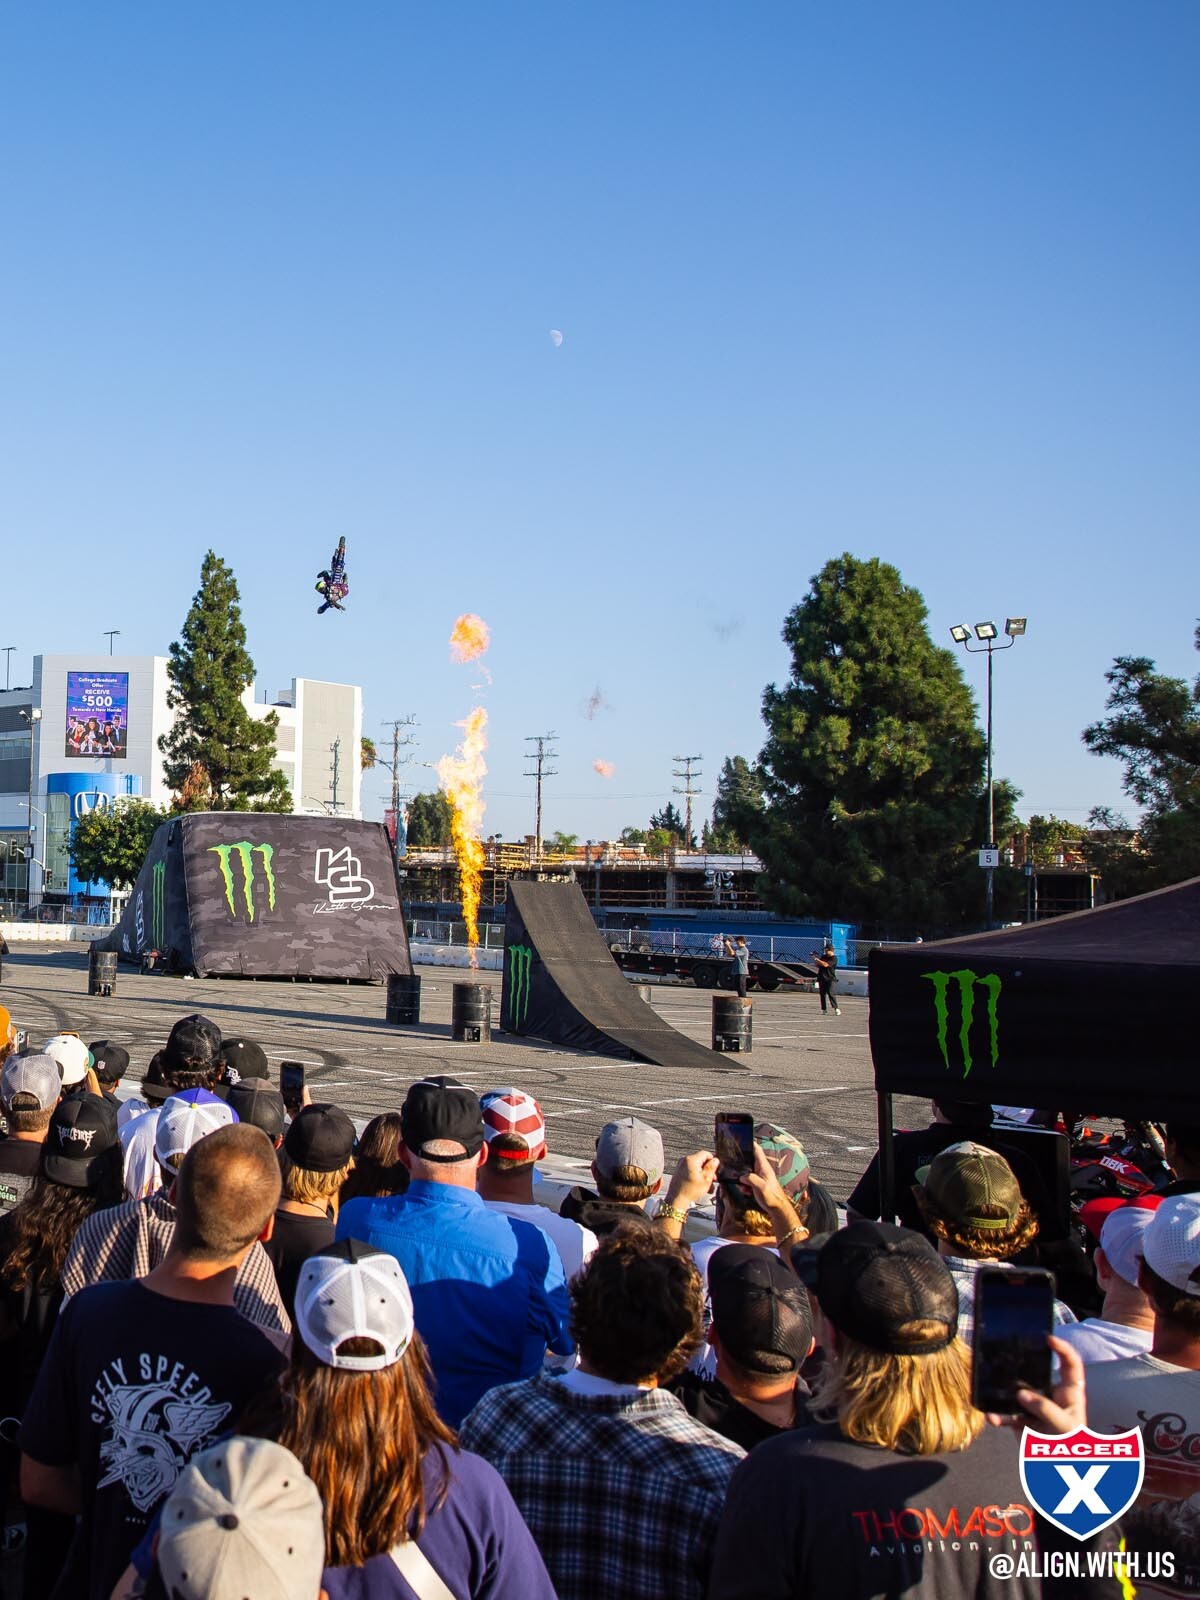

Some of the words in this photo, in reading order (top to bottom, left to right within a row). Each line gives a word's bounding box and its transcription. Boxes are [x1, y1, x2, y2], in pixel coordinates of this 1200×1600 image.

[82, 695, 113, 707] $500
[986, 855, 992, 863] 5
[139, 1353, 212, 1405] SPEED
